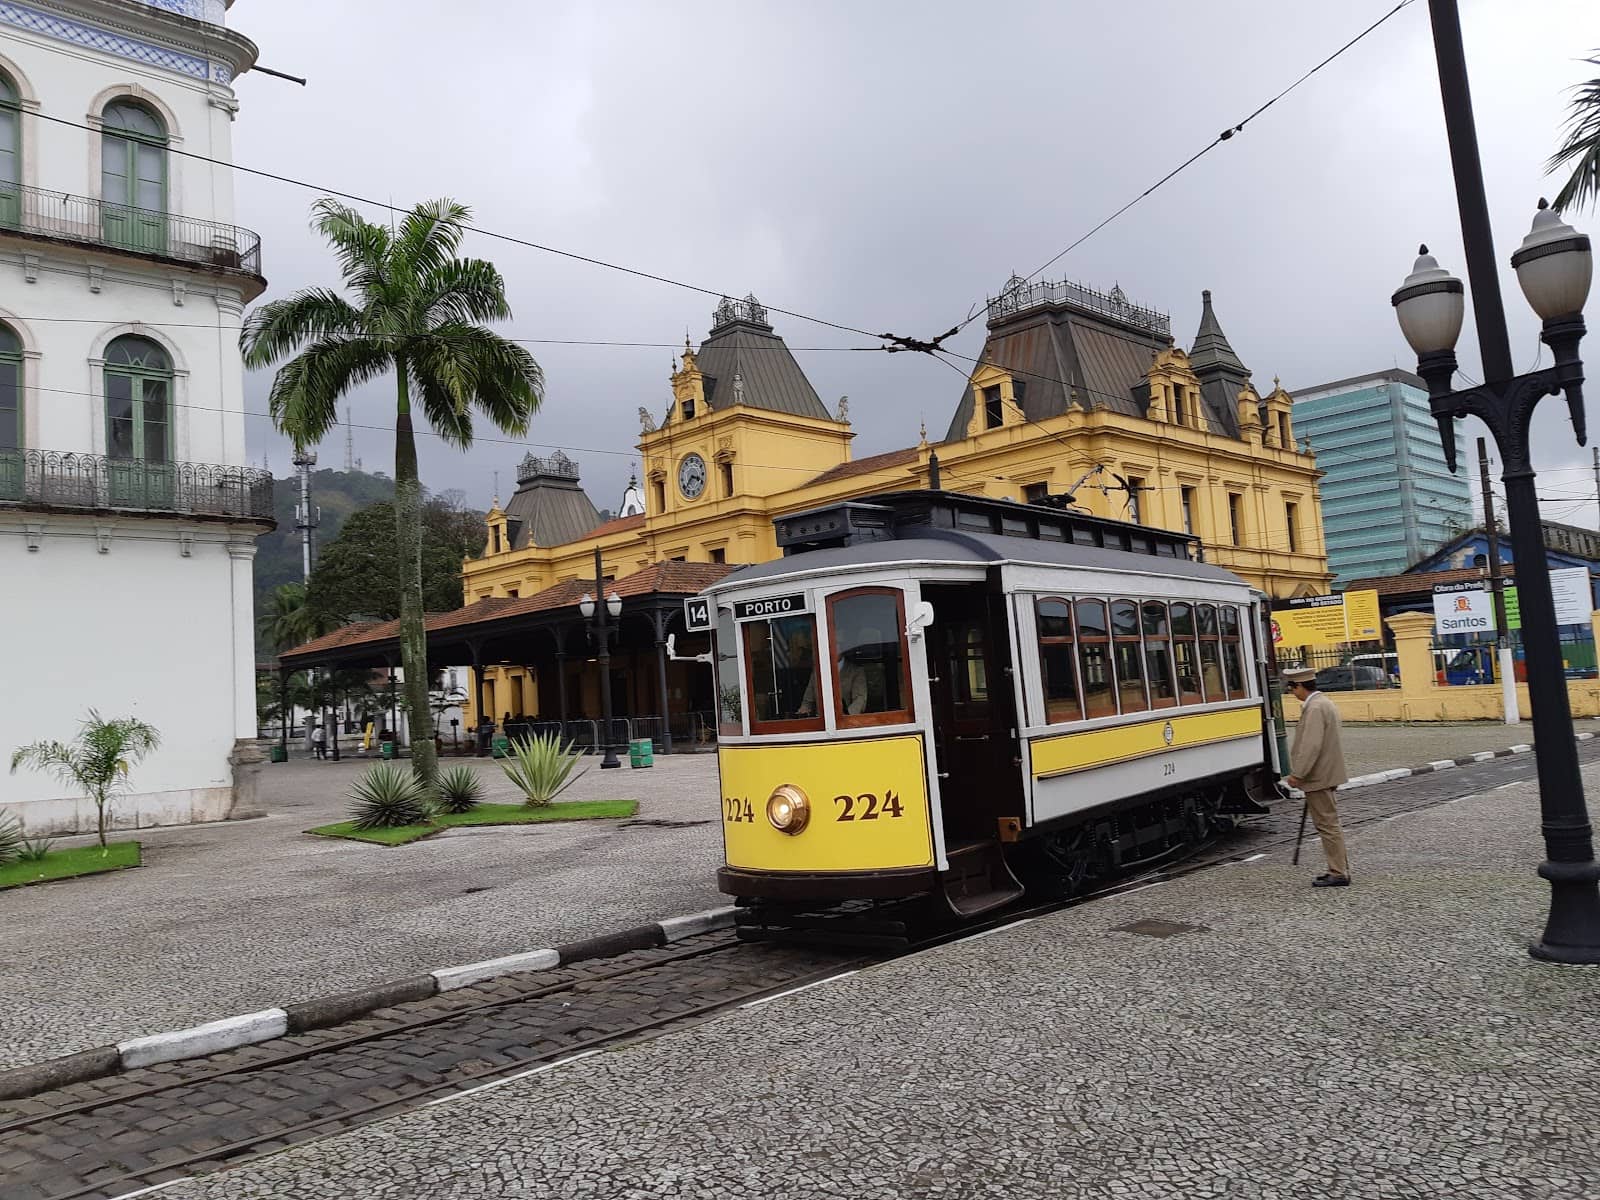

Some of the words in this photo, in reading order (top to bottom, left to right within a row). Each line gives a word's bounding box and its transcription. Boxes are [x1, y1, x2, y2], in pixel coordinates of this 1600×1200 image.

[690, 605, 708, 623] 14
[745, 598, 791, 616] PORTO
[1442, 617, 1487, 629] Santos
[1163, 761, 1175, 776] 224
[725, 795, 755, 823] 224
[833, 789, 905, 822] 224
